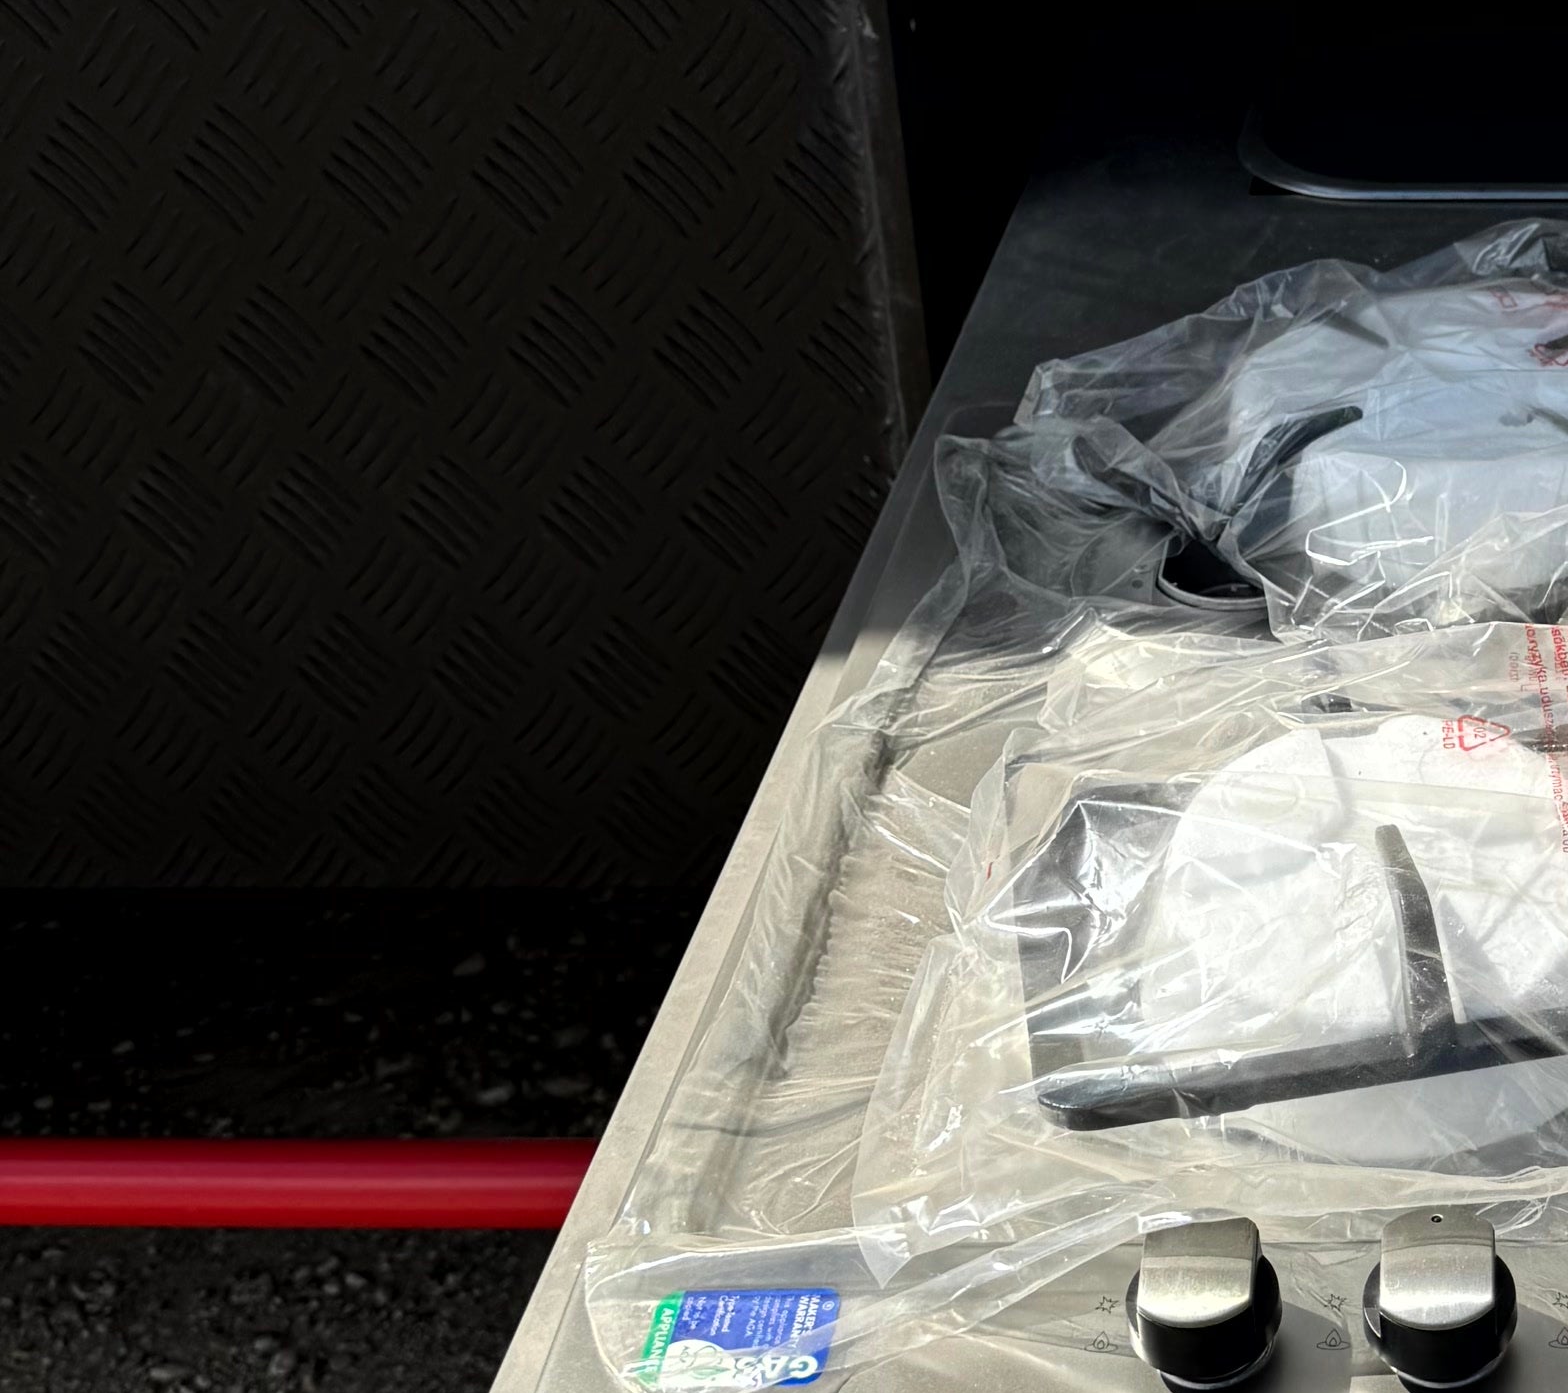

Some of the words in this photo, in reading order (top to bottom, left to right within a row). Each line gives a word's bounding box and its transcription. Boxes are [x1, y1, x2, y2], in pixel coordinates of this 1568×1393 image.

[1442, 720, 1455, 749] PE-LD
[1474, 727, 1486, 739] 02
[787, 1296, 809, 1348] WARRANTY
